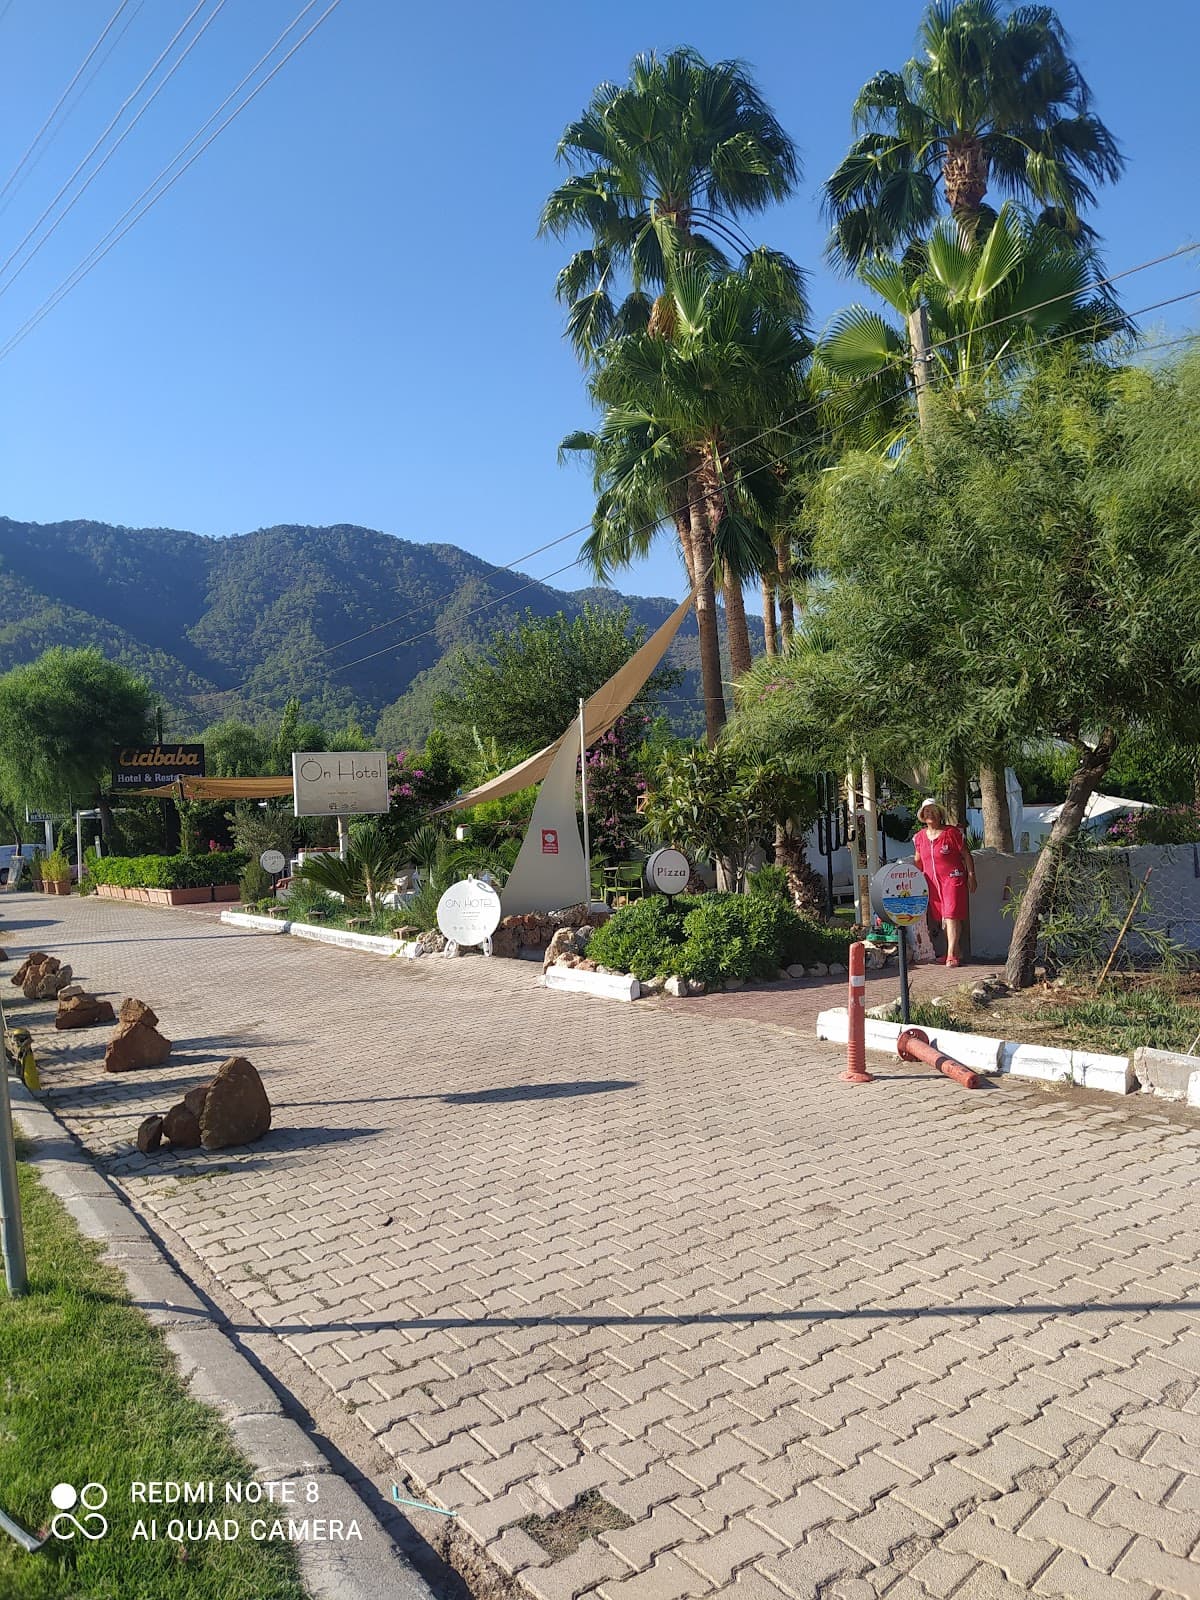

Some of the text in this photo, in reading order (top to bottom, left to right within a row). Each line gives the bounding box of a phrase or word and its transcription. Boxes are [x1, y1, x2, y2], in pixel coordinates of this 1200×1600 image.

[119, 747, 200, 766] Cicibaba
[300, 758, 382, 782] Ön Hotel
[117, 773, 142, 783] Hotel
[144, 774, 153, 783] &
[657, 867, 686, 877] Pizza
